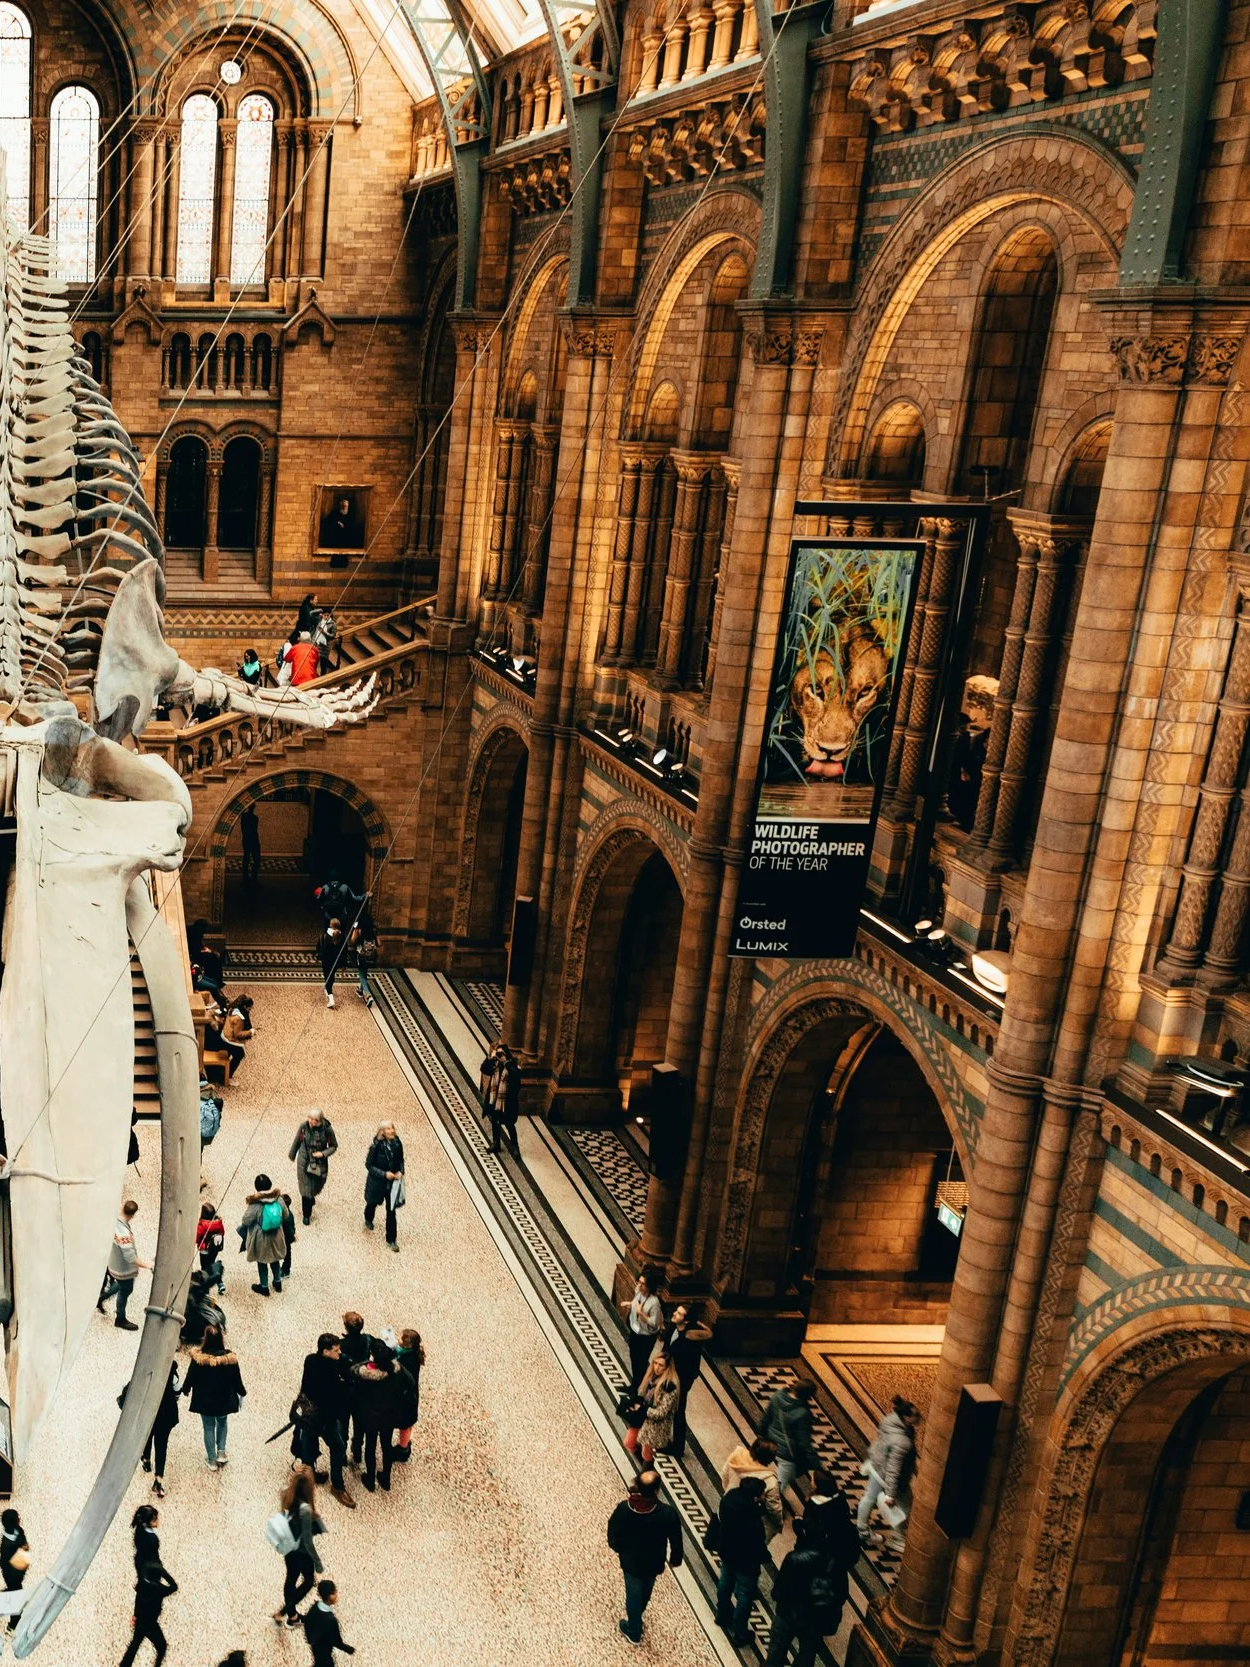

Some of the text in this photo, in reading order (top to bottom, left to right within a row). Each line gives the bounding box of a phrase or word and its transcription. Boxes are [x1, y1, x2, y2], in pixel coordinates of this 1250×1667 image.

[754, 824, 819, 839] WILDLIFE
[751, 840, 865, 856] PHOTOGRAPHER
[749, 856, 828, 871] OF THE YEAR
[736, 938, 789, 951] LUMIX
